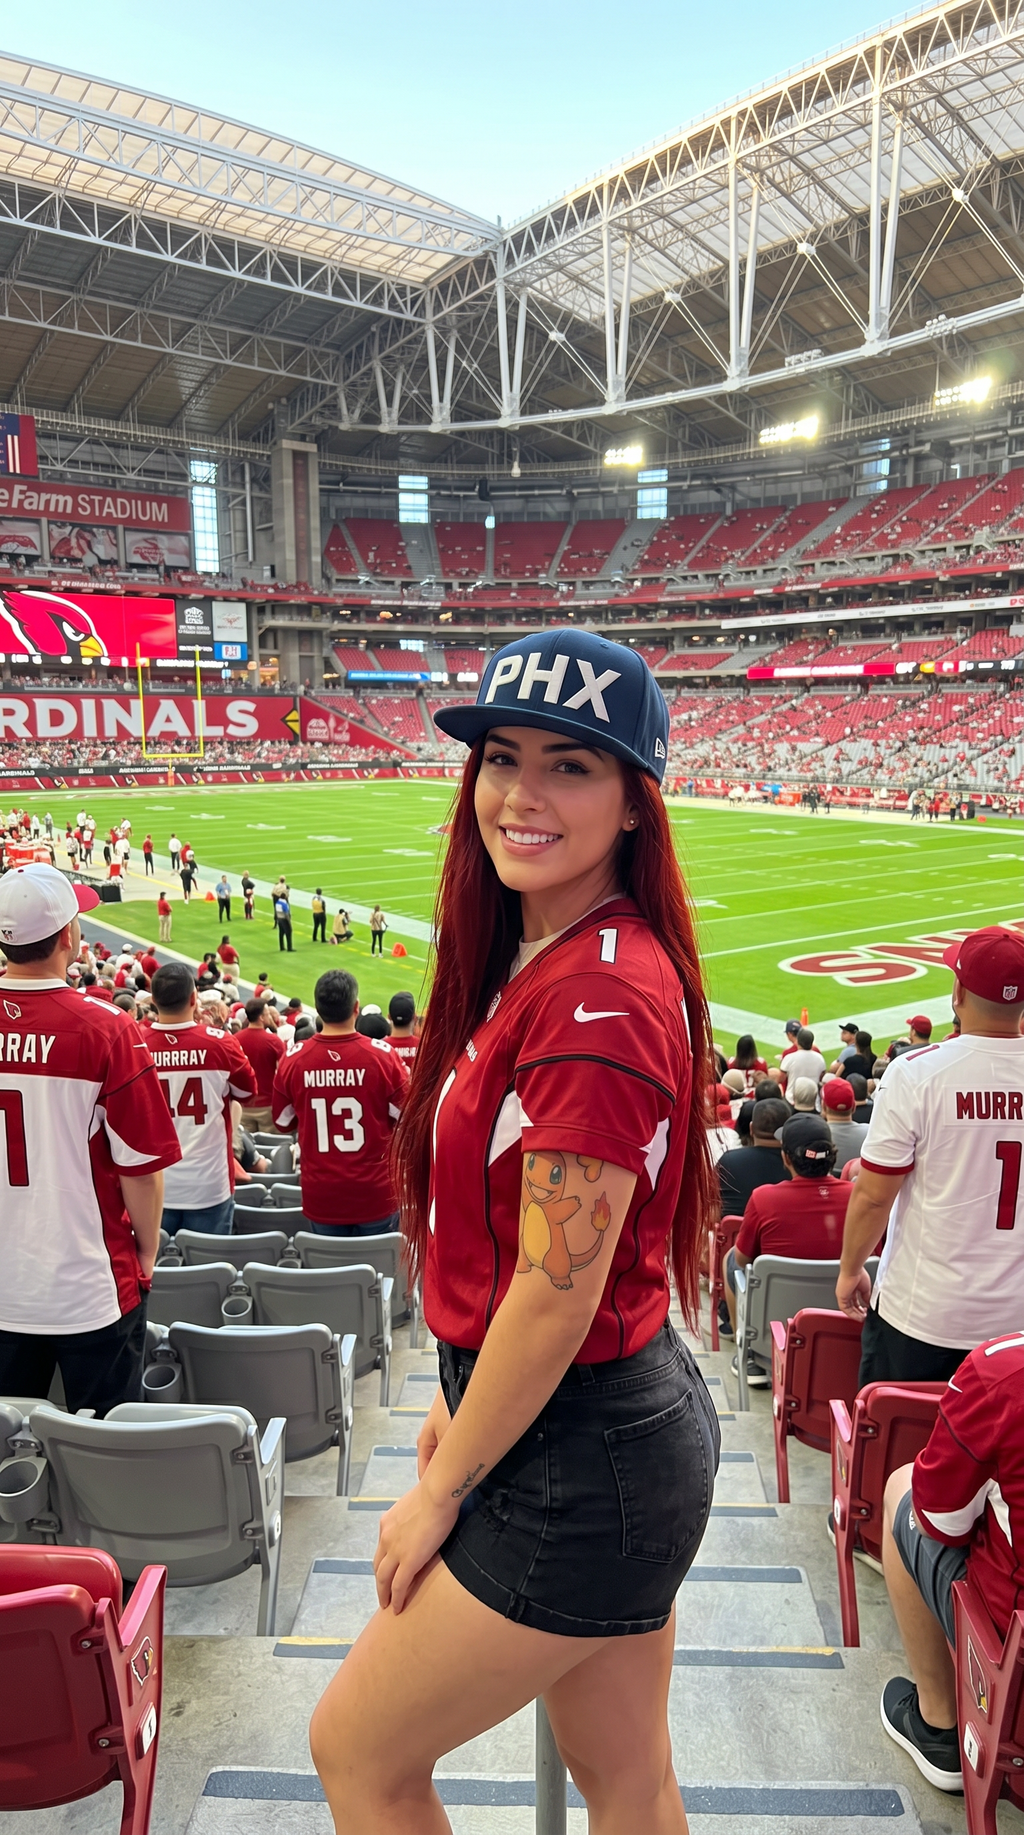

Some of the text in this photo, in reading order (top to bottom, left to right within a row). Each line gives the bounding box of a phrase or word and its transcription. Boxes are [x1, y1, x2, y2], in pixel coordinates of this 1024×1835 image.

[77, 493, 169, 523] STADIUM
[485, 652, 622, 724] PHX
[0, 697, 260, 738] RDINALS
[598, 927, 619, 965] 1
[151, 1048, 208, 1068] URRRAY
[303, 1068, 366, 1088] MURRAY
[310, 1096, 366, 1153] 13
[955, 1091, 1024, 1121] MURR
[995, 1140, 1023, 1231] 1
